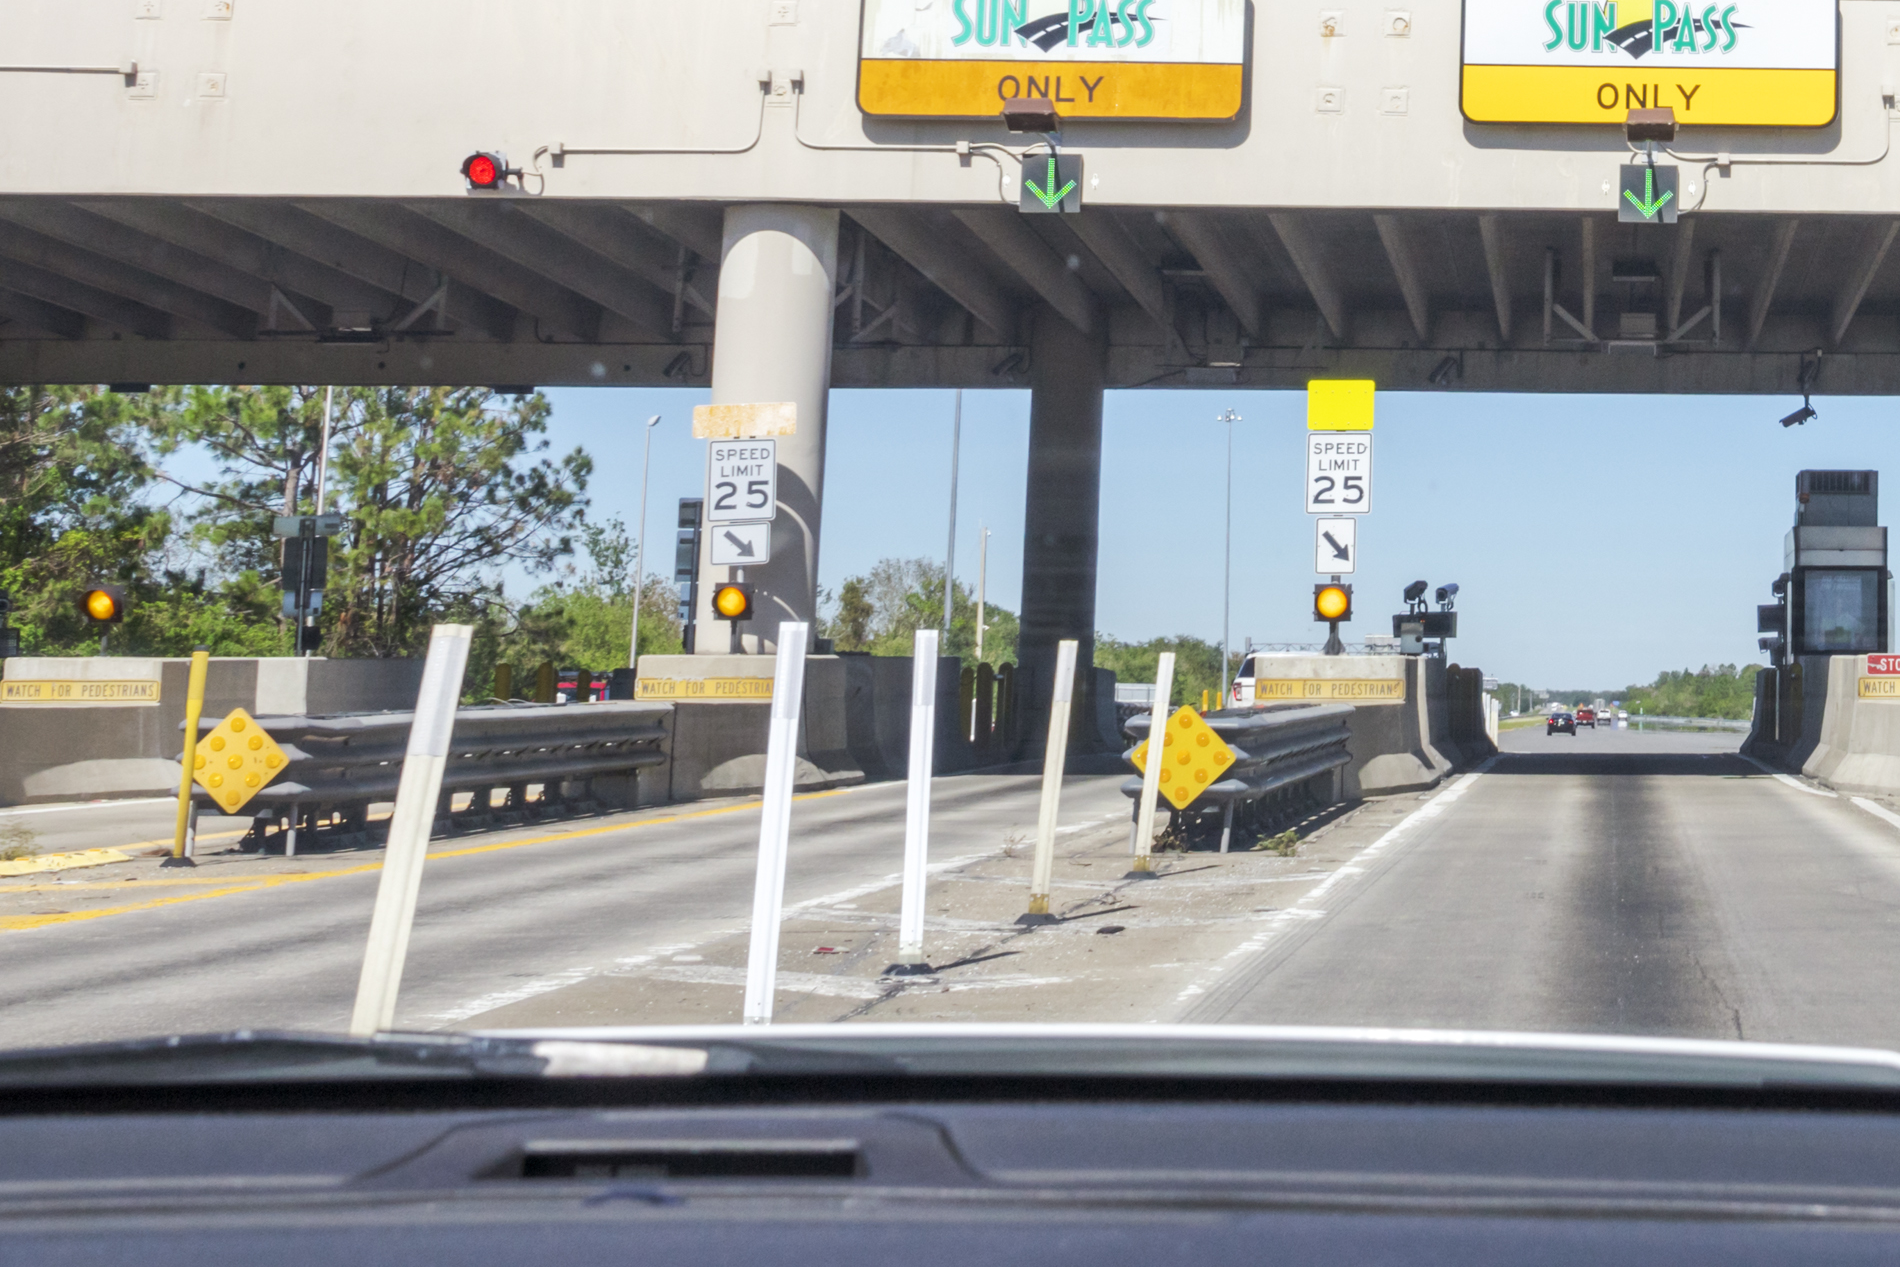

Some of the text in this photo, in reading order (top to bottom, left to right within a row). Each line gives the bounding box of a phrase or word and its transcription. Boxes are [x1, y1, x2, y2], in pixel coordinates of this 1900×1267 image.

[997, 75, 1105, 103] ONLY
[1597, 82, 1701, 111] ONLY
[715, 448, 770, 461] SPEED
[1313, 442, 1367, 455] SPEED
[721, 464, 764, 478] LIMIT
[1318, 459, 1360, 471] LIMIT
[714, 480, 769, 511] 25
[1312, 475, 1365, 504] 25
[7, 684, 154, 697] WATCH FOR PEDESTRIANS
[641, 681, 774, 694] WATCH FOR PEDESTRIA
[1260, 683, 1292, 695] WATCH
[1303, 683, 1321, 696] FOR
[1863, 681, 1896, 694] WATCH
